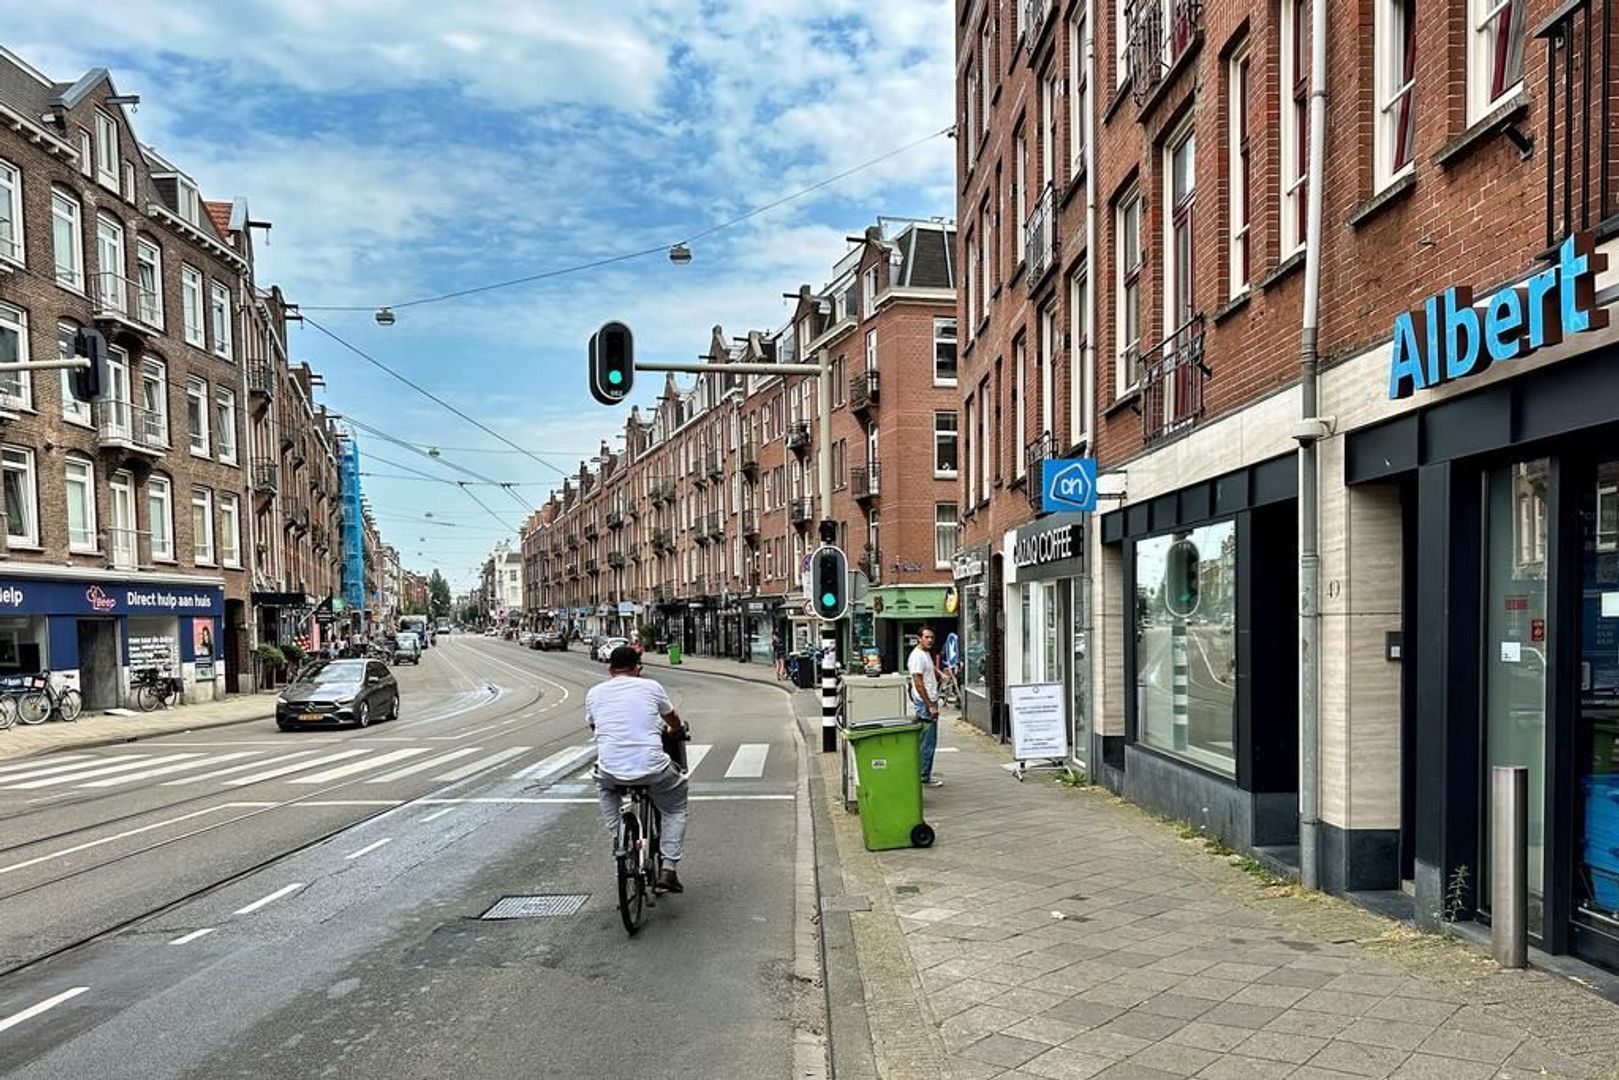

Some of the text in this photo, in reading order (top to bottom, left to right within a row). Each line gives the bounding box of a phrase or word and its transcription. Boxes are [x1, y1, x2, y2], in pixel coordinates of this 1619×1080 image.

[1388, 232, 1592, 401] Albert
[1039, 524, 1072, 562] COFFEE
[127, 591, 156, 606] Direct
[157, 592, 177, 609] hulp
[178, 595, 194, 607] aan
[194, 594, 212, 607] huis
